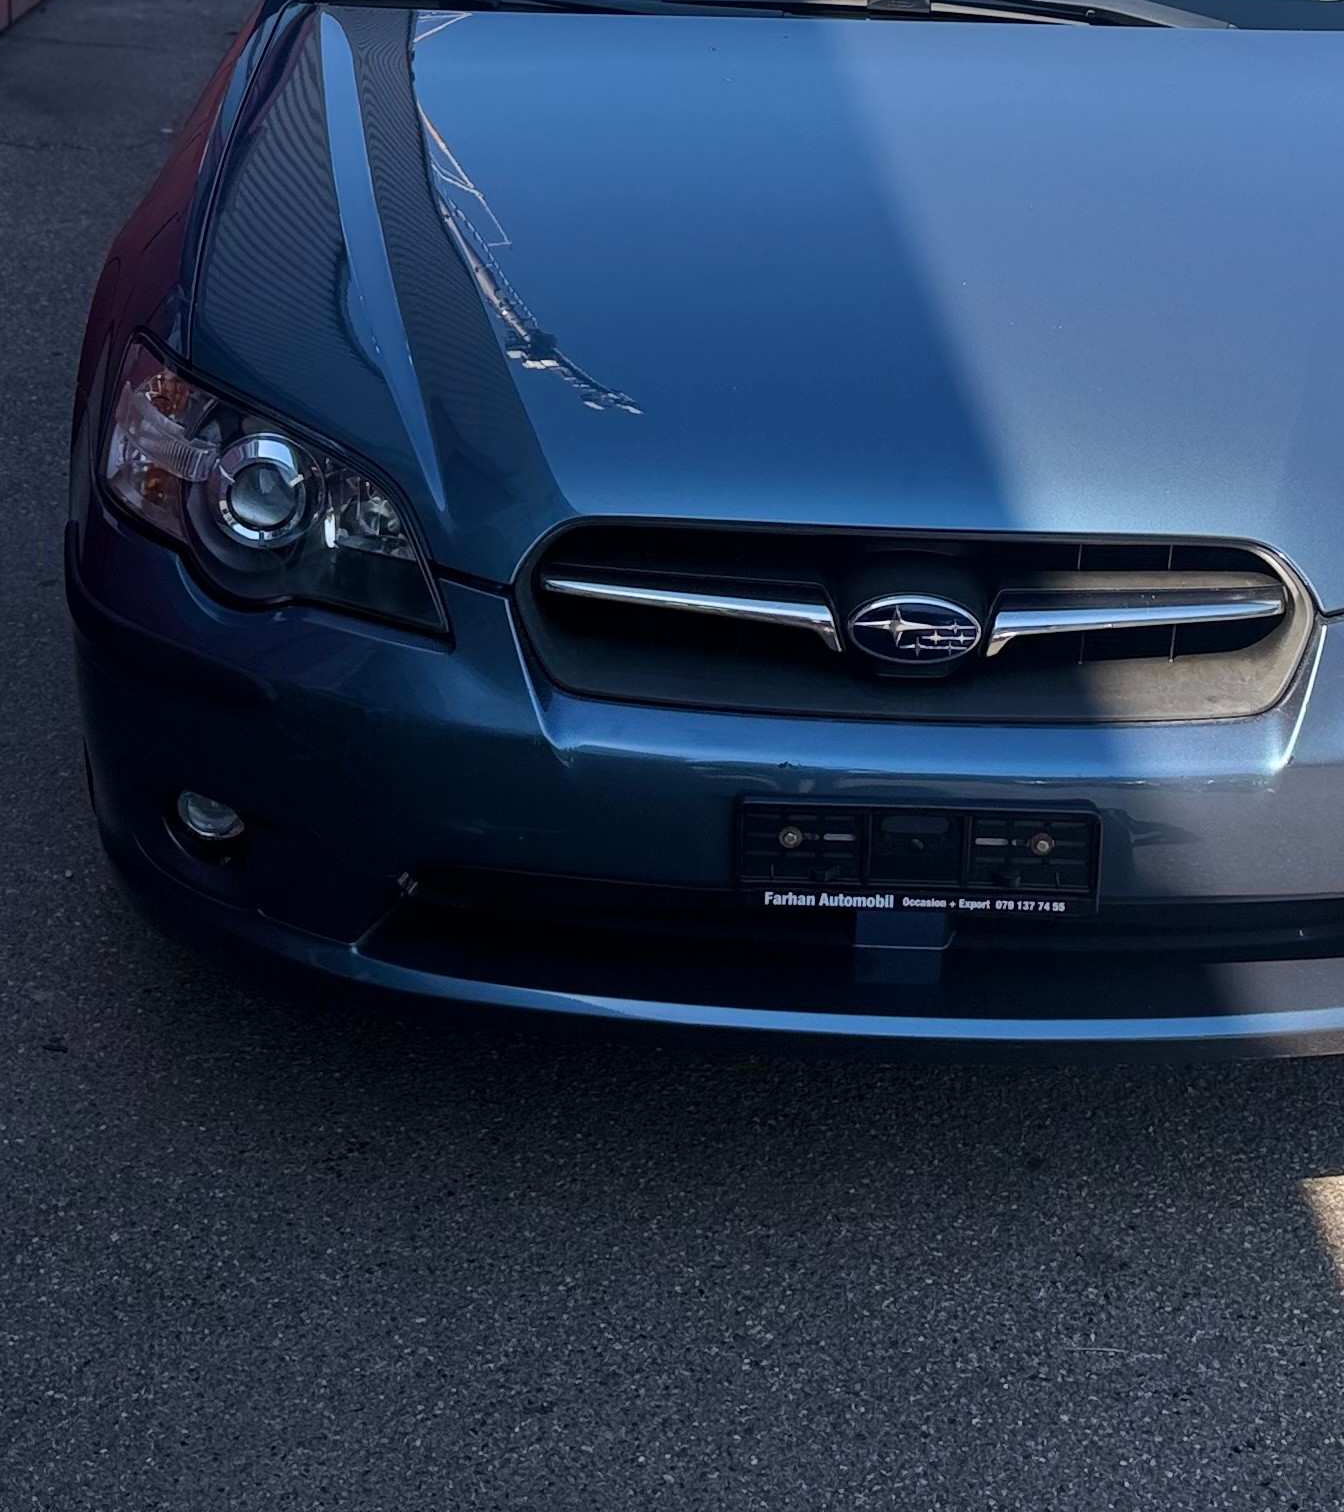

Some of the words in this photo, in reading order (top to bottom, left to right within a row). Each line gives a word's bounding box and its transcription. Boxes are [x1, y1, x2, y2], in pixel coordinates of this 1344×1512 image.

[764, 891, 816, 906] Farhan
[818, 892, 895, 909] Automobil
[902, 896, 947, 908] Occasion
[958, 898, 991, 910] Export
[1017, 900, 1035, 911] 137
